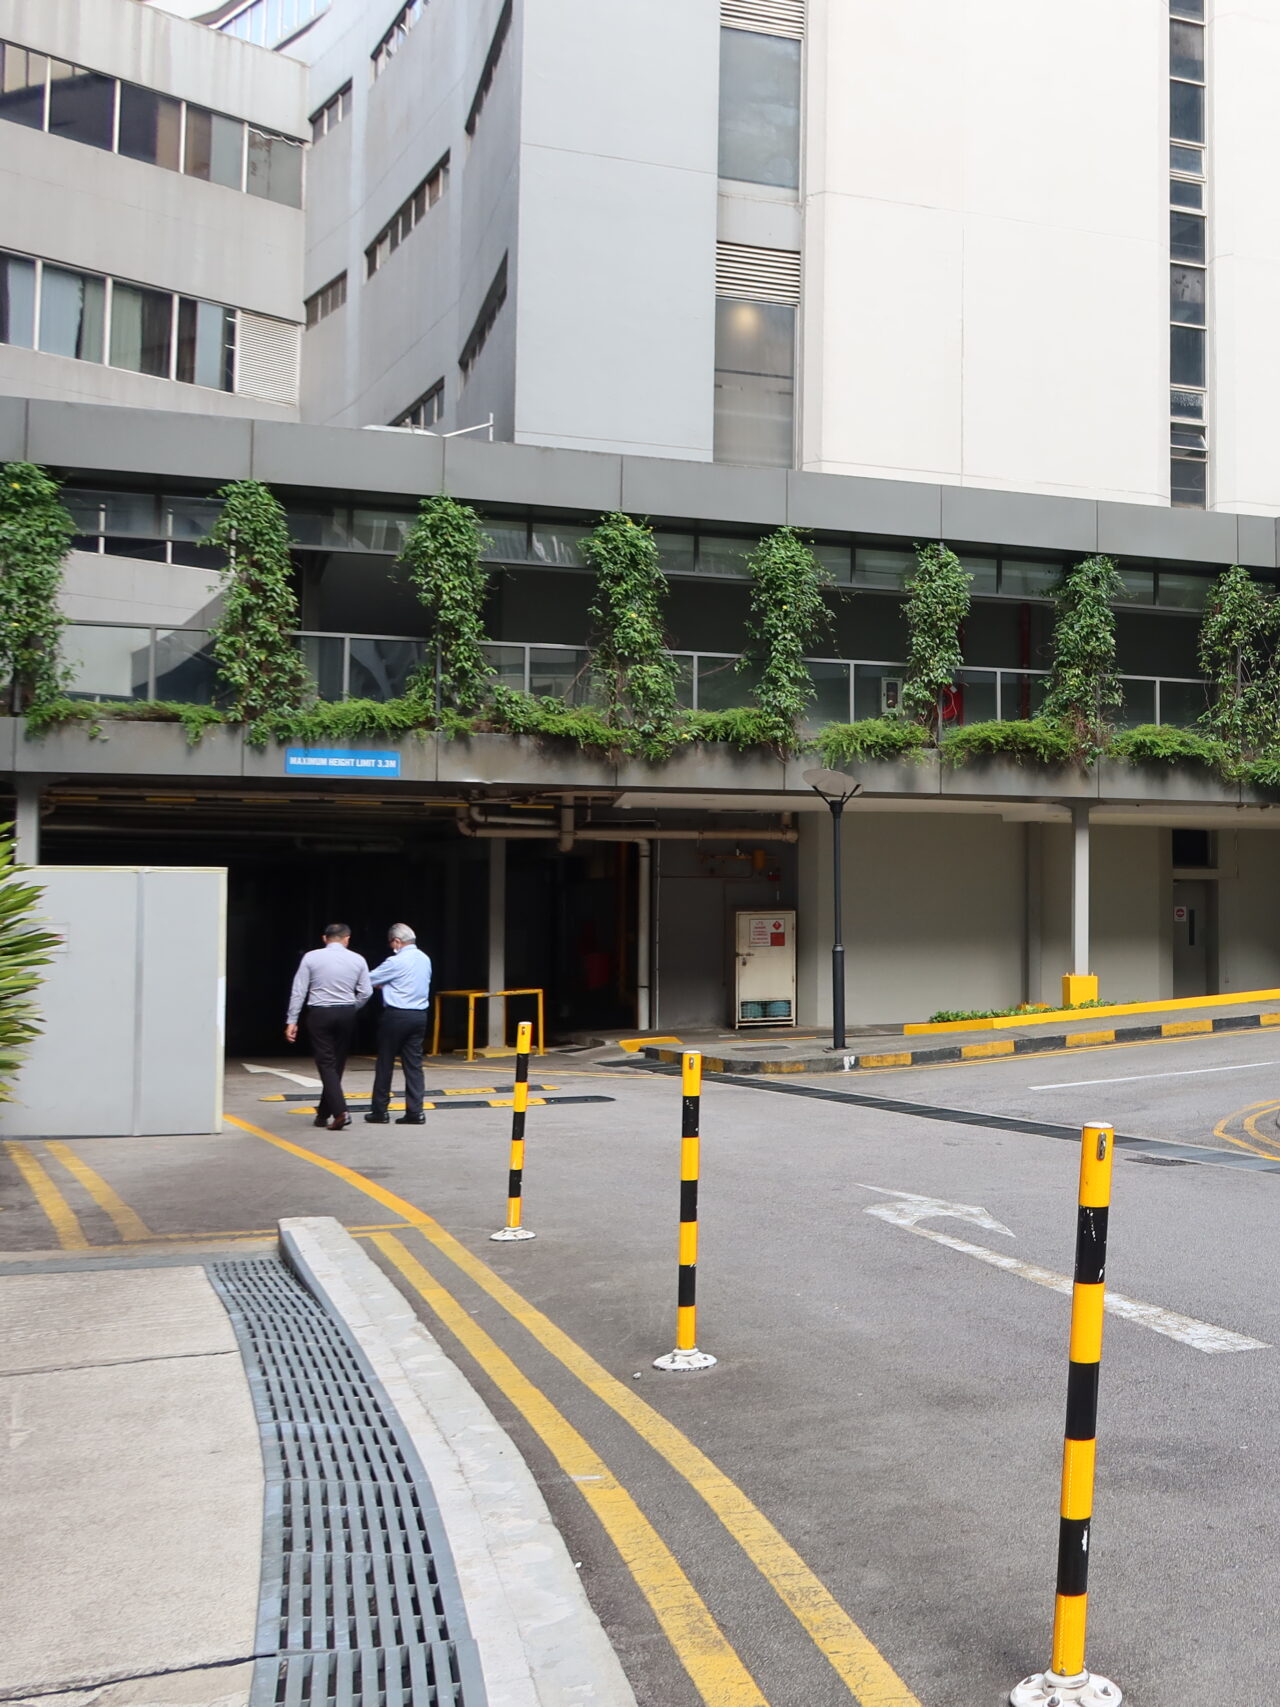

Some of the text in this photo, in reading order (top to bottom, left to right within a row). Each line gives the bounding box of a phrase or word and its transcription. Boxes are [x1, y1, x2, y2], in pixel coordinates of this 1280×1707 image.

[289, 756, 327, 766] MAXIMUM
[328, 757, 354, 767] HEIGHT
[355, 758, 375, 768] LIMIT
